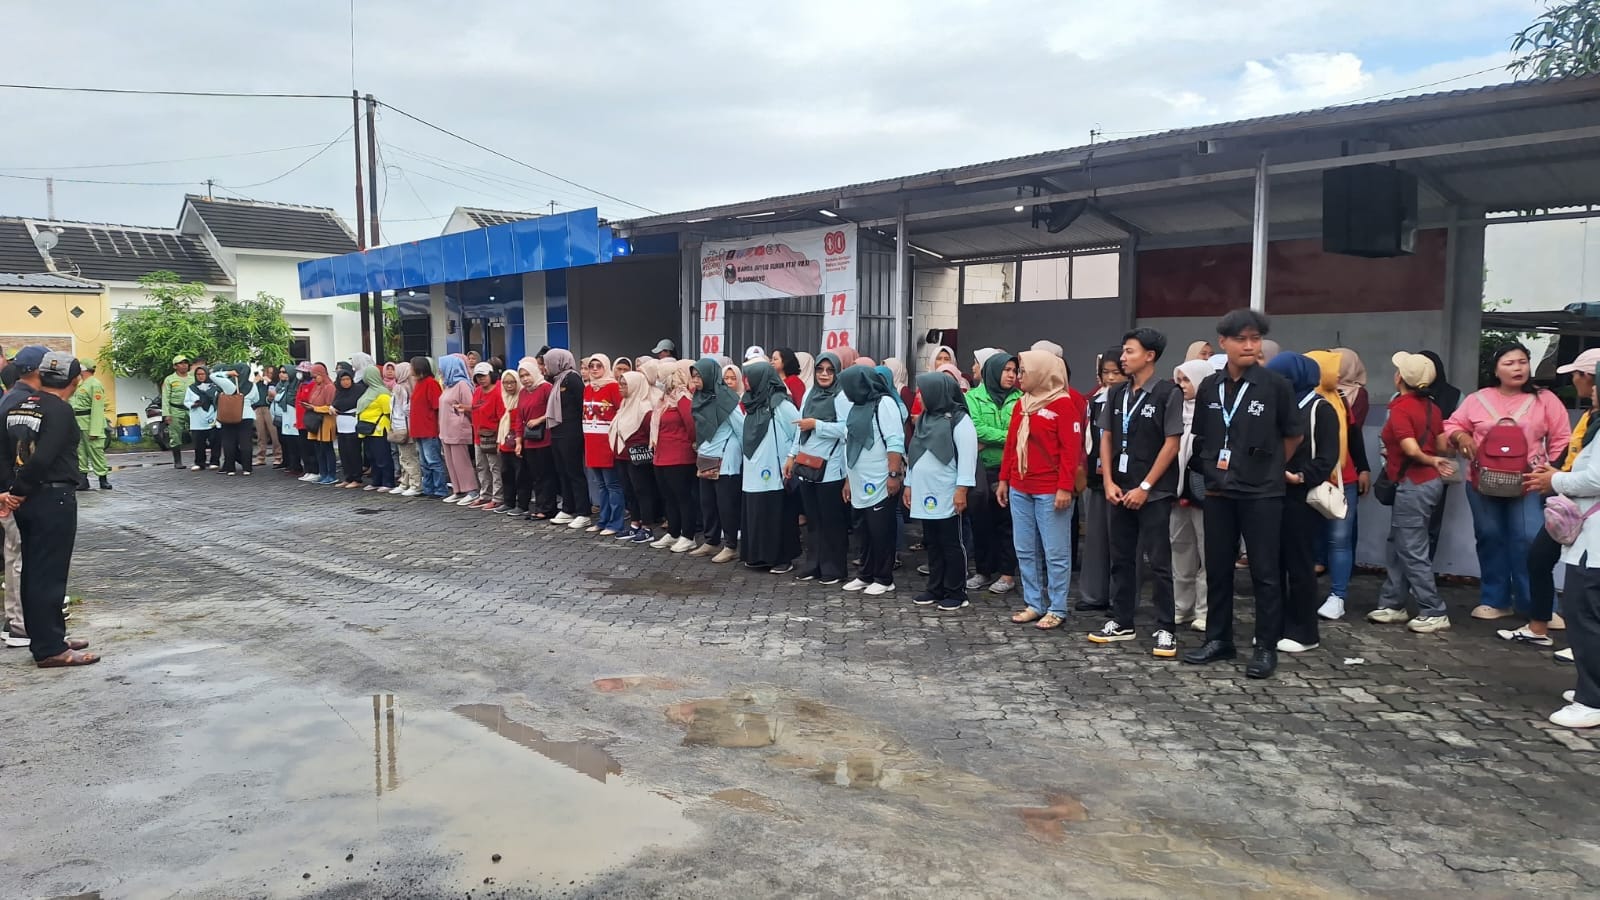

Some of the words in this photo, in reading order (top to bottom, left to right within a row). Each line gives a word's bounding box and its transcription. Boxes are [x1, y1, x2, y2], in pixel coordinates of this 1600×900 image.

[824, 231, 846, 255] 80
[705, 302, 717, 322] 17
[831, 293, 846, 316] 17
[702, 335, 719, 354] 08
